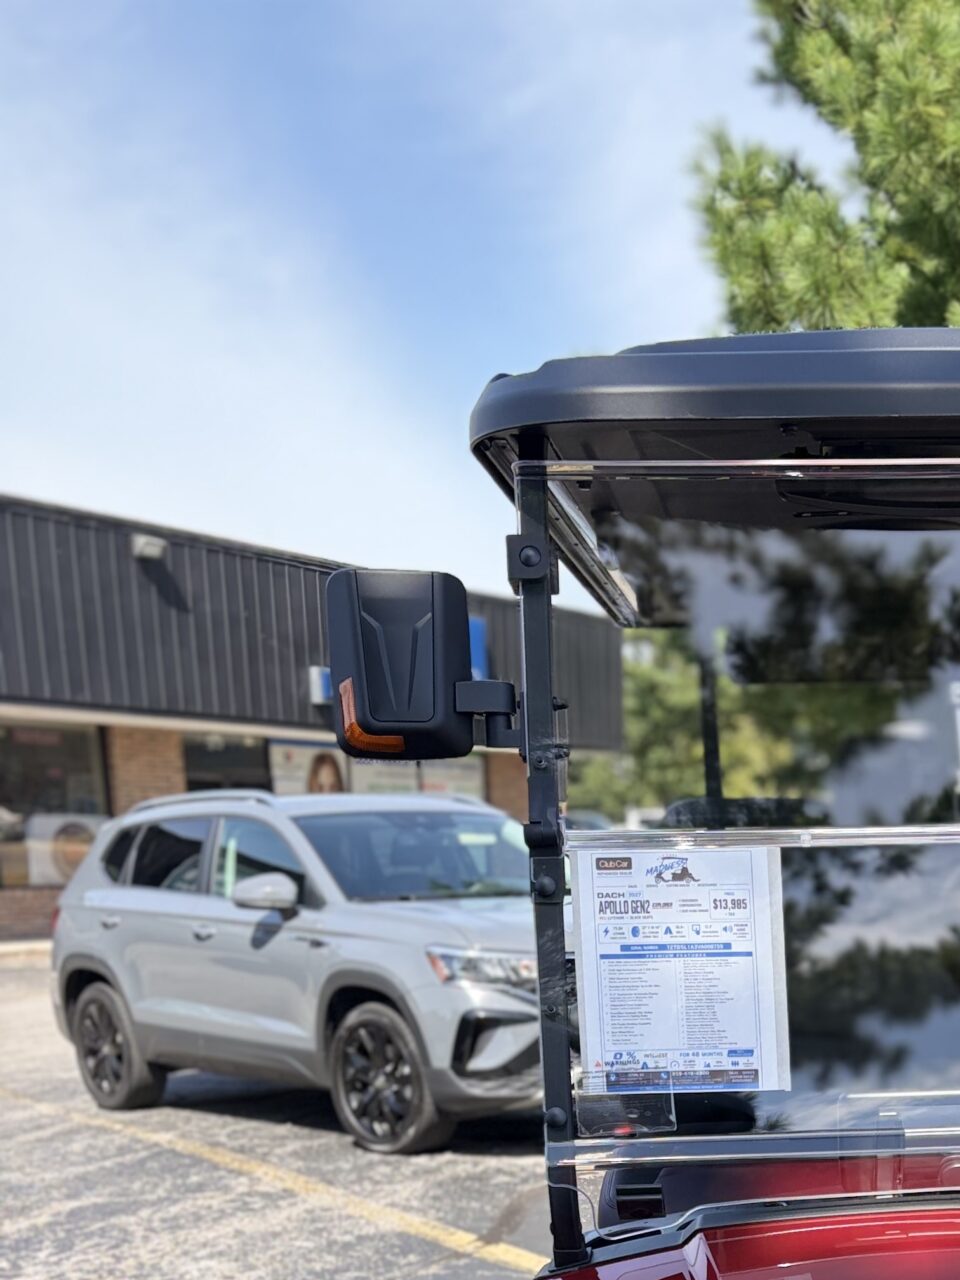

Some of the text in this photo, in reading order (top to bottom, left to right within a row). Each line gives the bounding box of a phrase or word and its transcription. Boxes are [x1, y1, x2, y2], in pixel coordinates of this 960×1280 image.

[599, 860, 629, 868] Club Car
[599, 900, 629, 915] APOLLO
[631, 899, 651, 914] GEN2
[712, 897, 748, 911] $13,985
